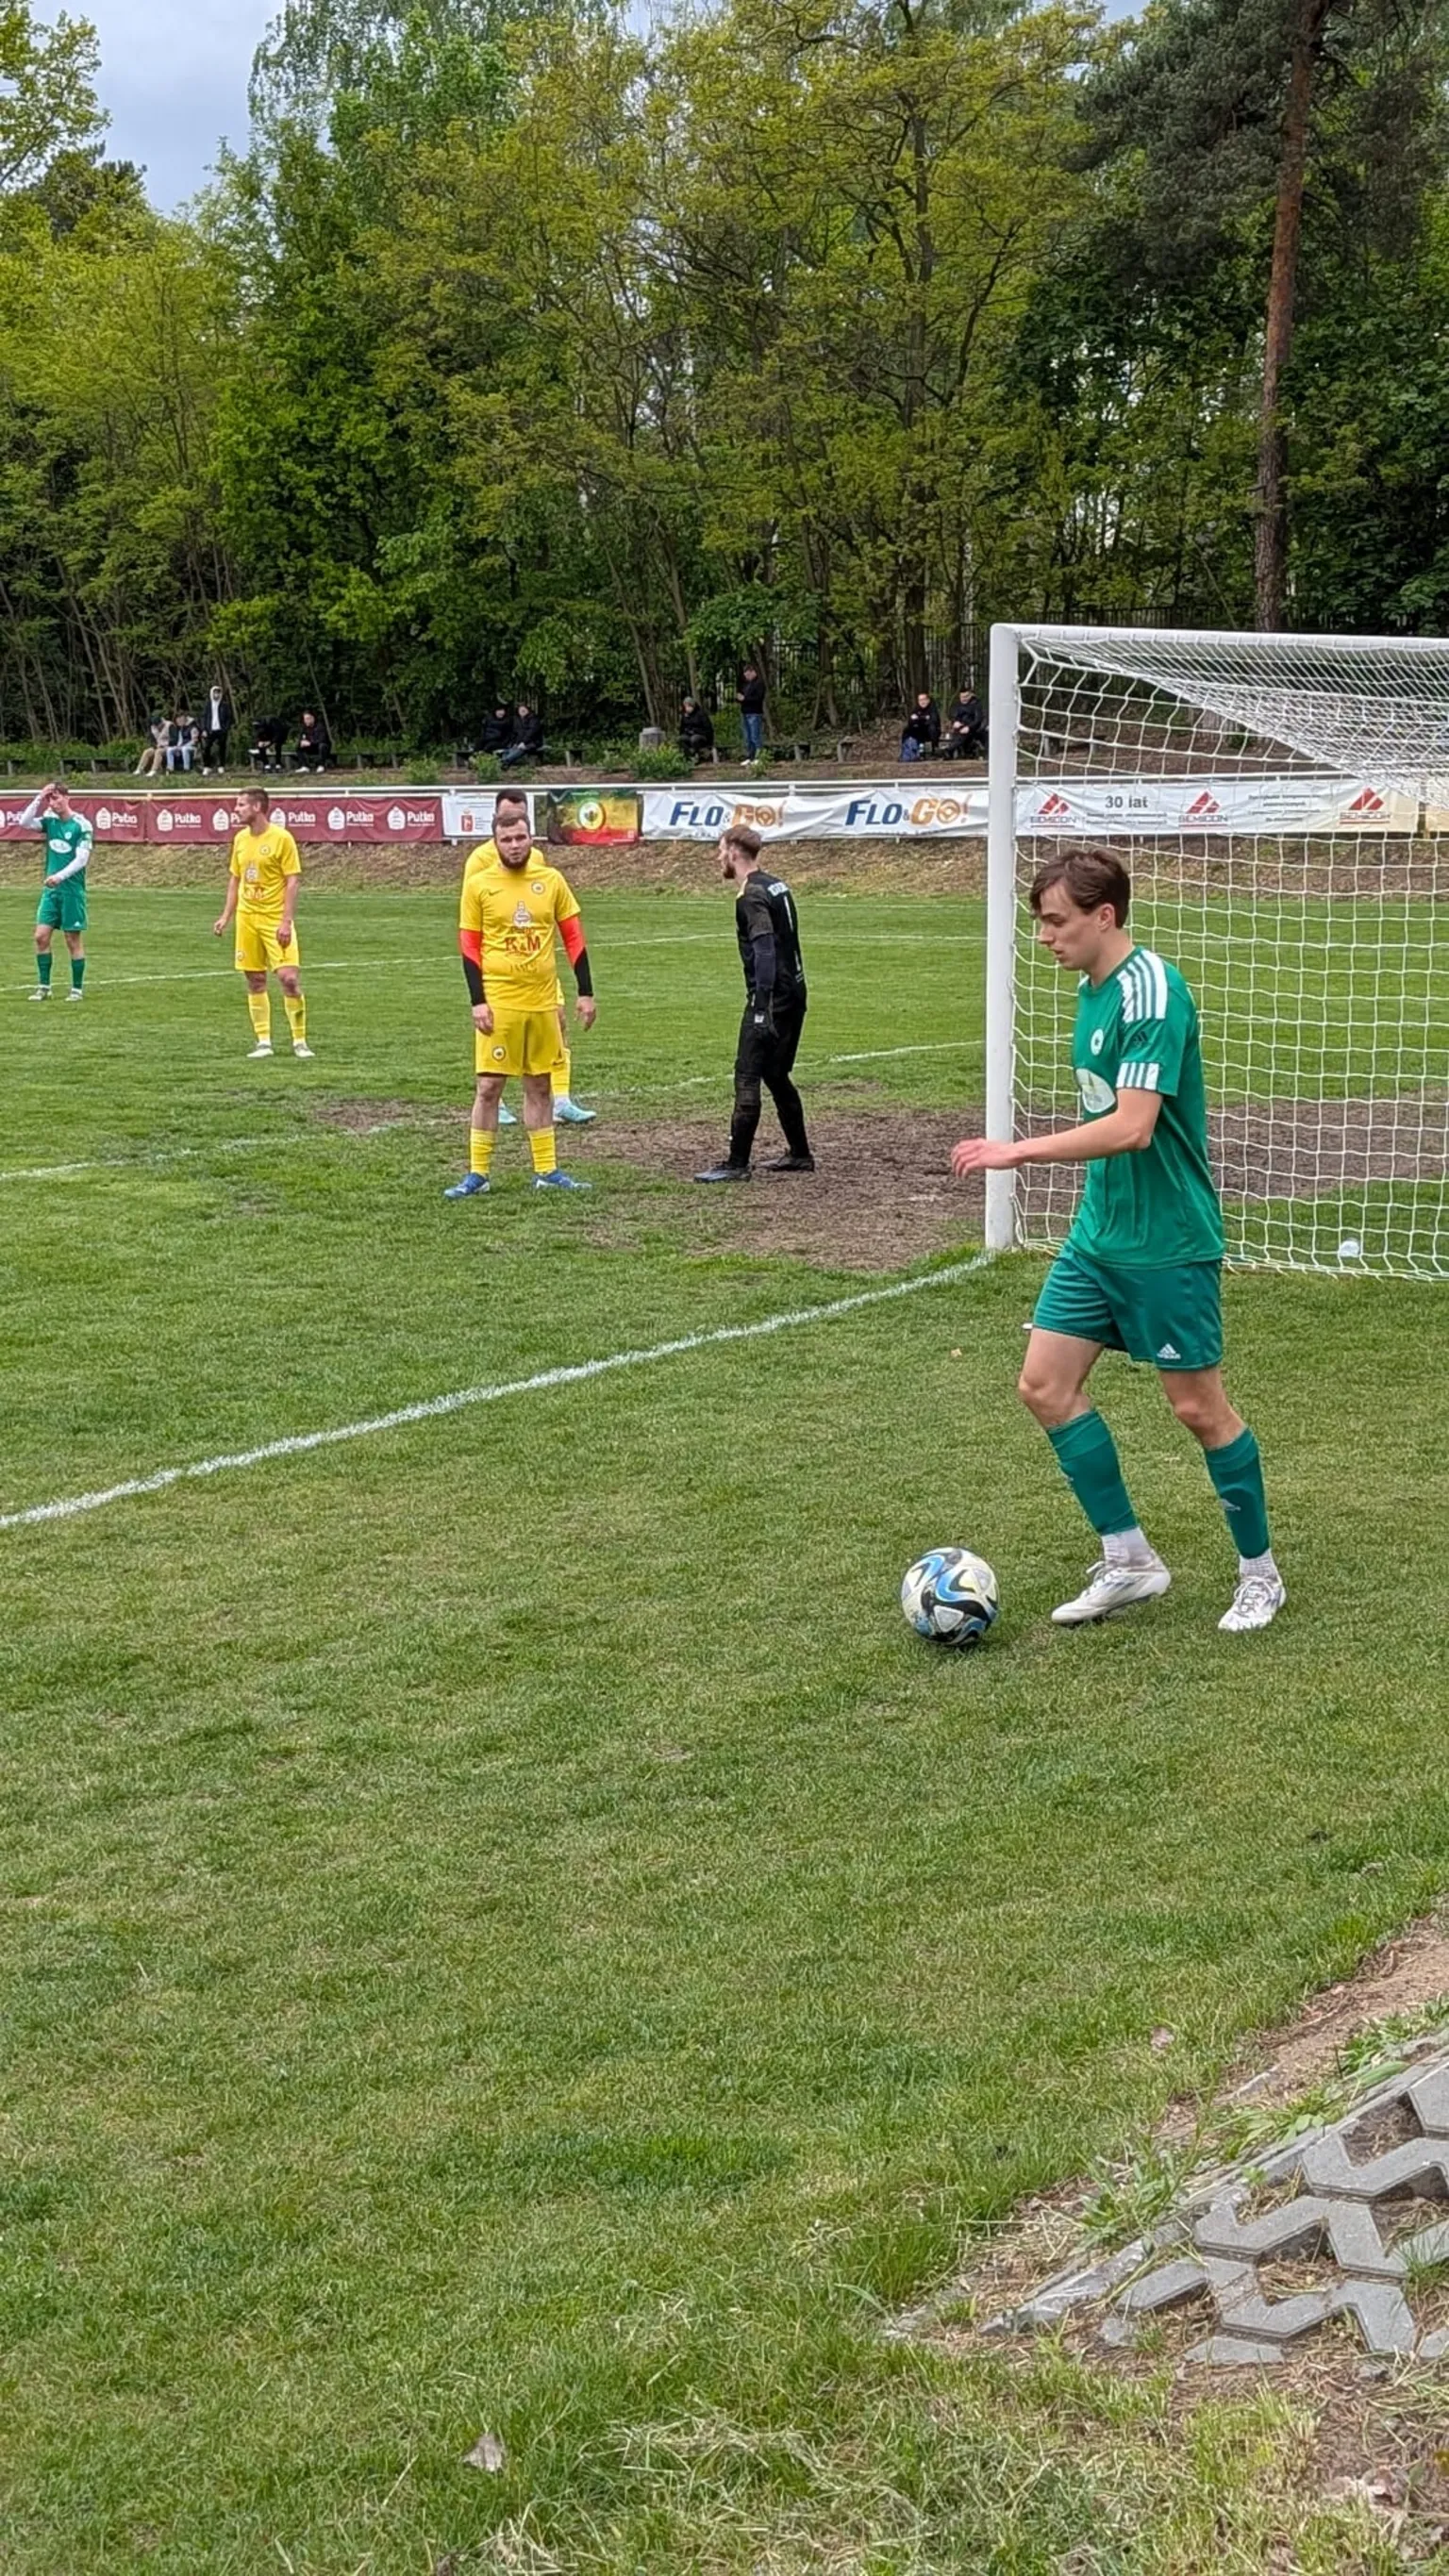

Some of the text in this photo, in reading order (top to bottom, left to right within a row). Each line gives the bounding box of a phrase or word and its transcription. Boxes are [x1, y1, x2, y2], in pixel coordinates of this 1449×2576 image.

[1105, 795, 1148, 808] 30 lat
[288, 811, 316, 823] Putka
[346, 811, 375, 823] Putka
[408, 811, 435, 823] Putka
